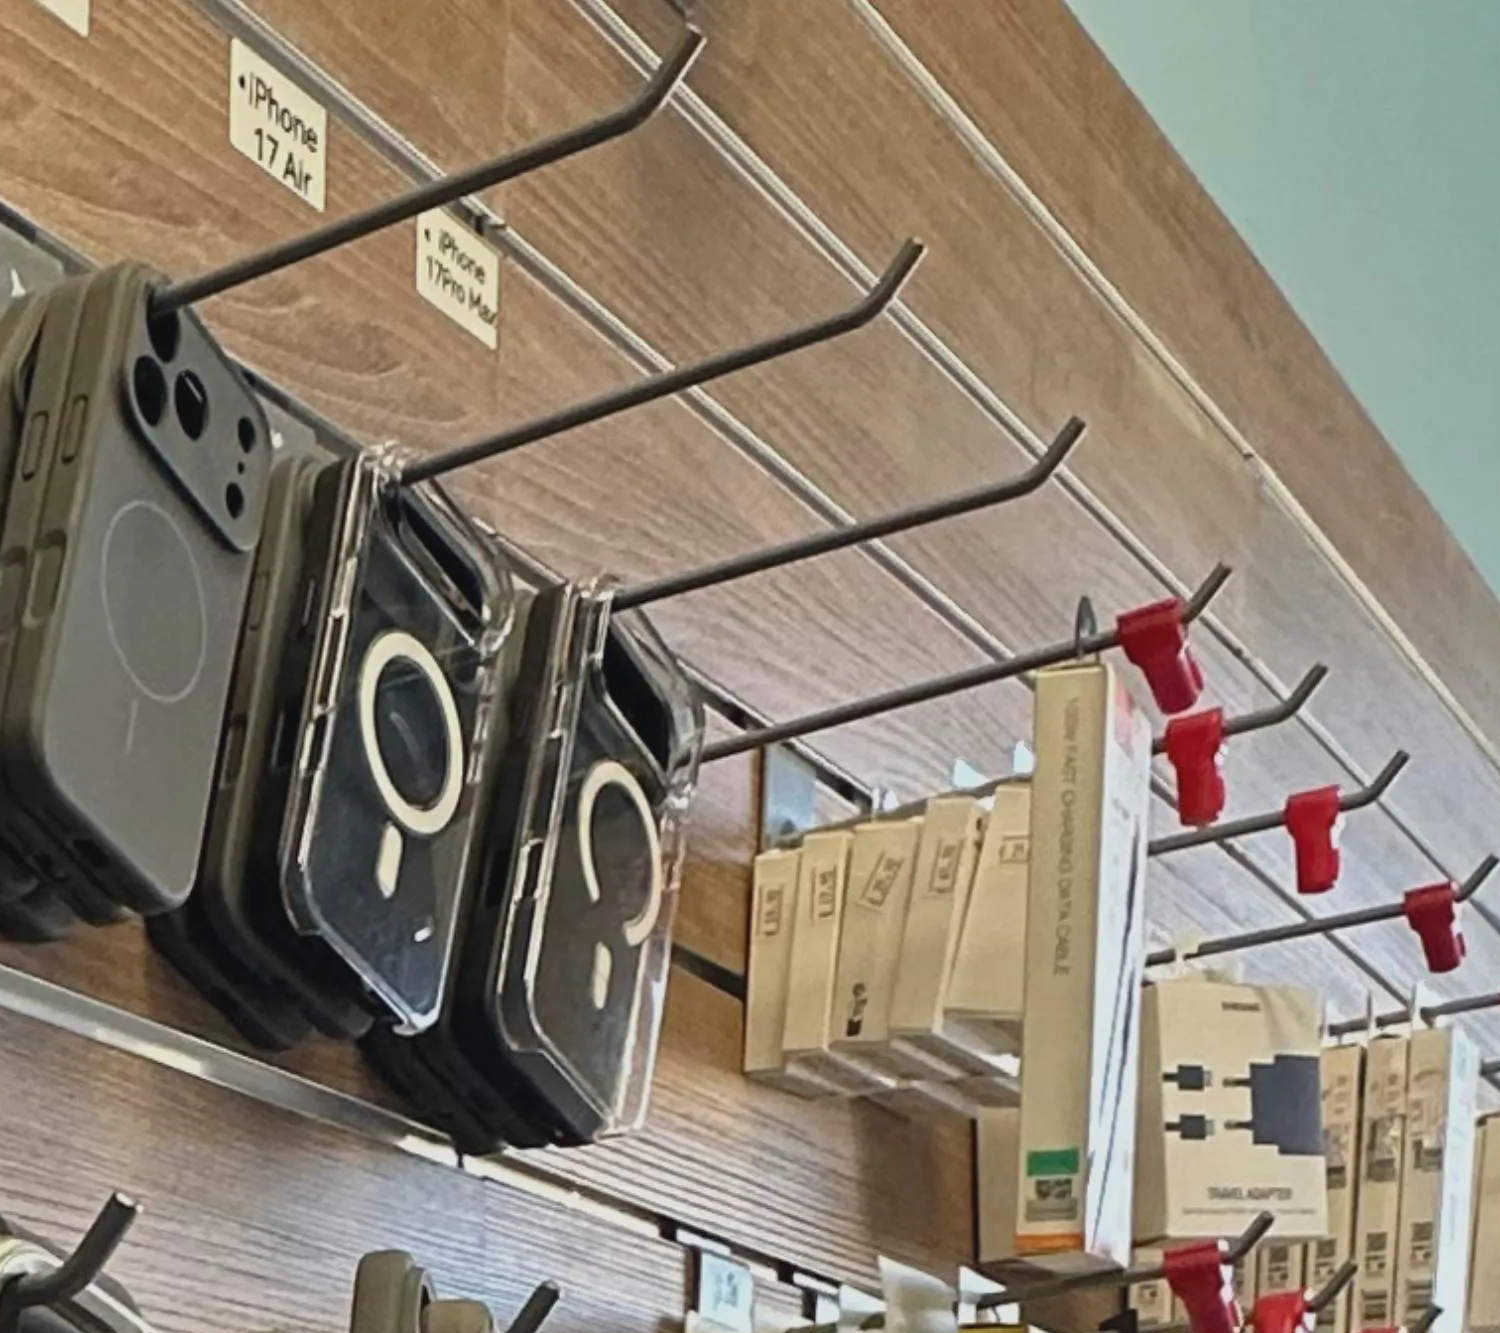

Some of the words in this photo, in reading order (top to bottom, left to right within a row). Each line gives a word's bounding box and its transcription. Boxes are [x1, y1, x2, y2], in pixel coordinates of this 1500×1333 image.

[248, 71, 319, 153] iPhone
[253, 127, 279, 167] 17
[283, 153, 313, 197] Air
[438, 229, 487, 285] iPhone
